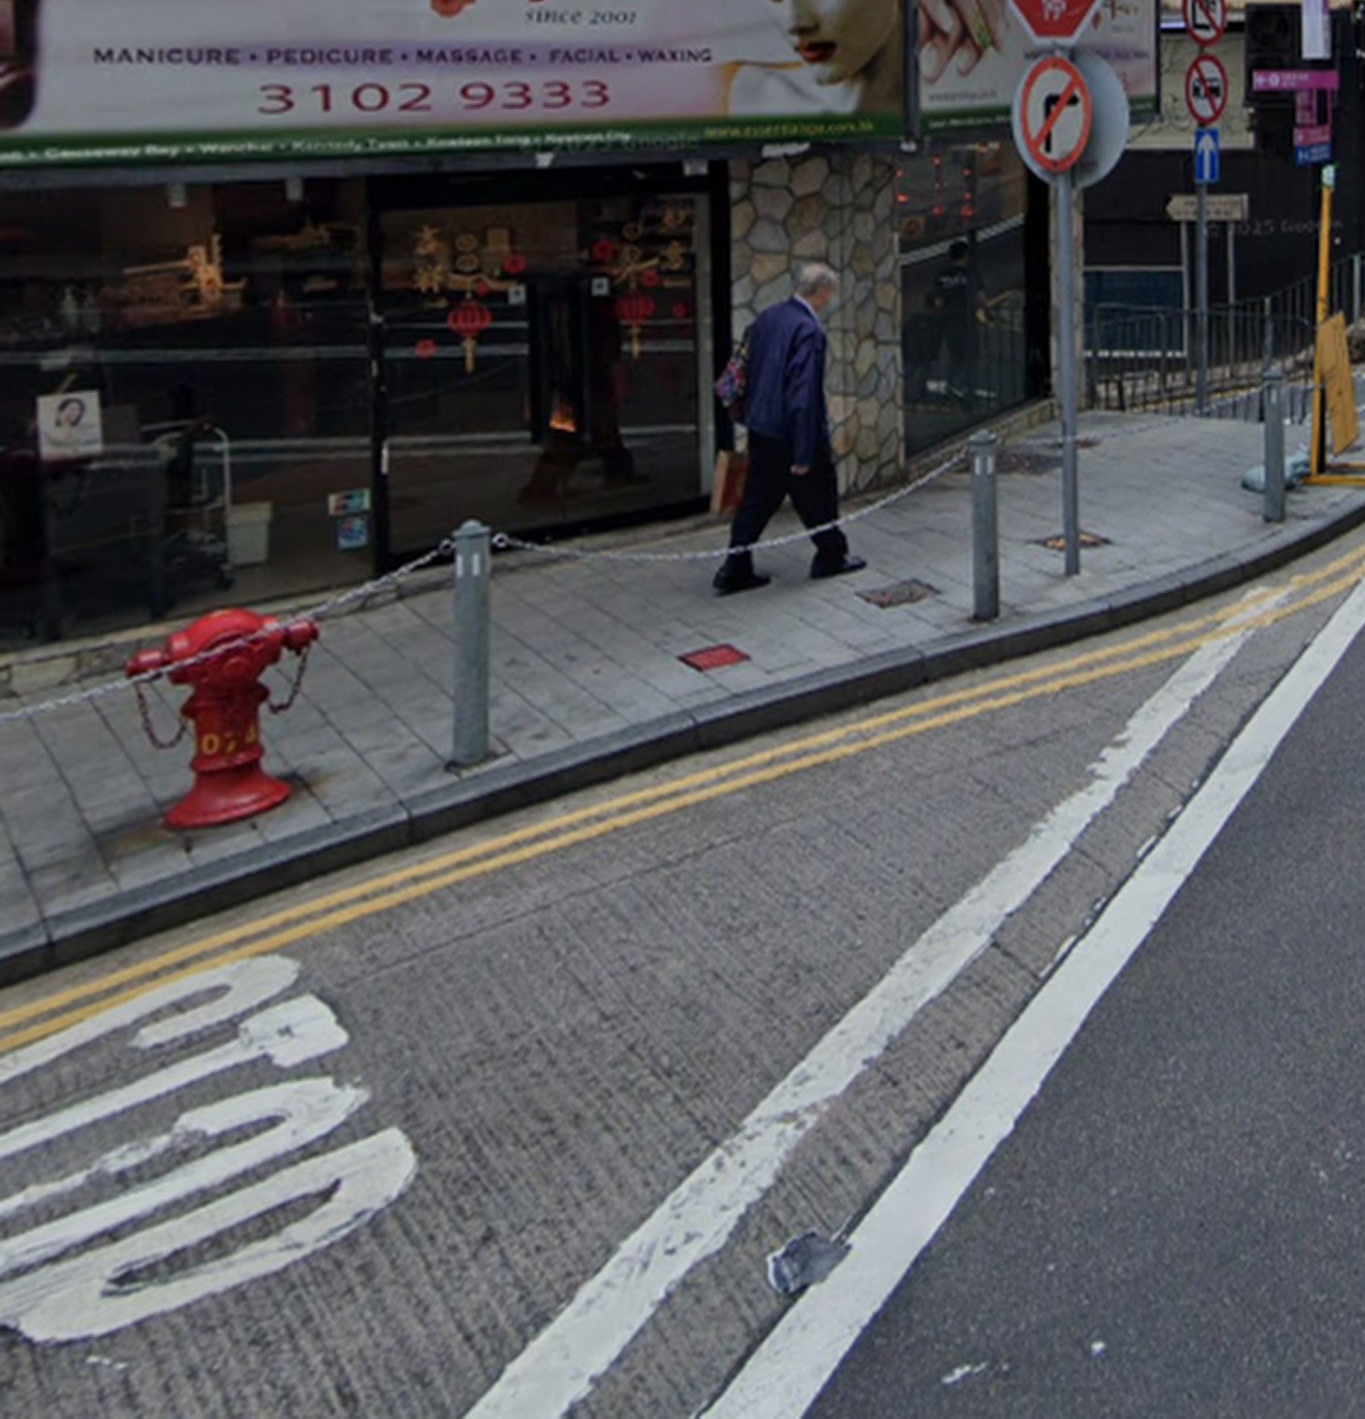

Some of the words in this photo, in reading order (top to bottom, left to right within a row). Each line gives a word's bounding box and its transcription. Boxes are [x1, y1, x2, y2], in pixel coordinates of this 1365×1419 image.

[525, 6, 582, 25] since
[590, 9, 638, 26] 2001
[93, 47, 241, 66] MANICURE
[265, 47, 394, 66] PEDICURE
[415, 47, 524, 65] MASSAGE
[550, 47, 621, 64] FACIAL
[636, 46, 714, 64] WAXING
[257, 82, 433, 115] 3102
[458, 80, 612, 111] 9333
